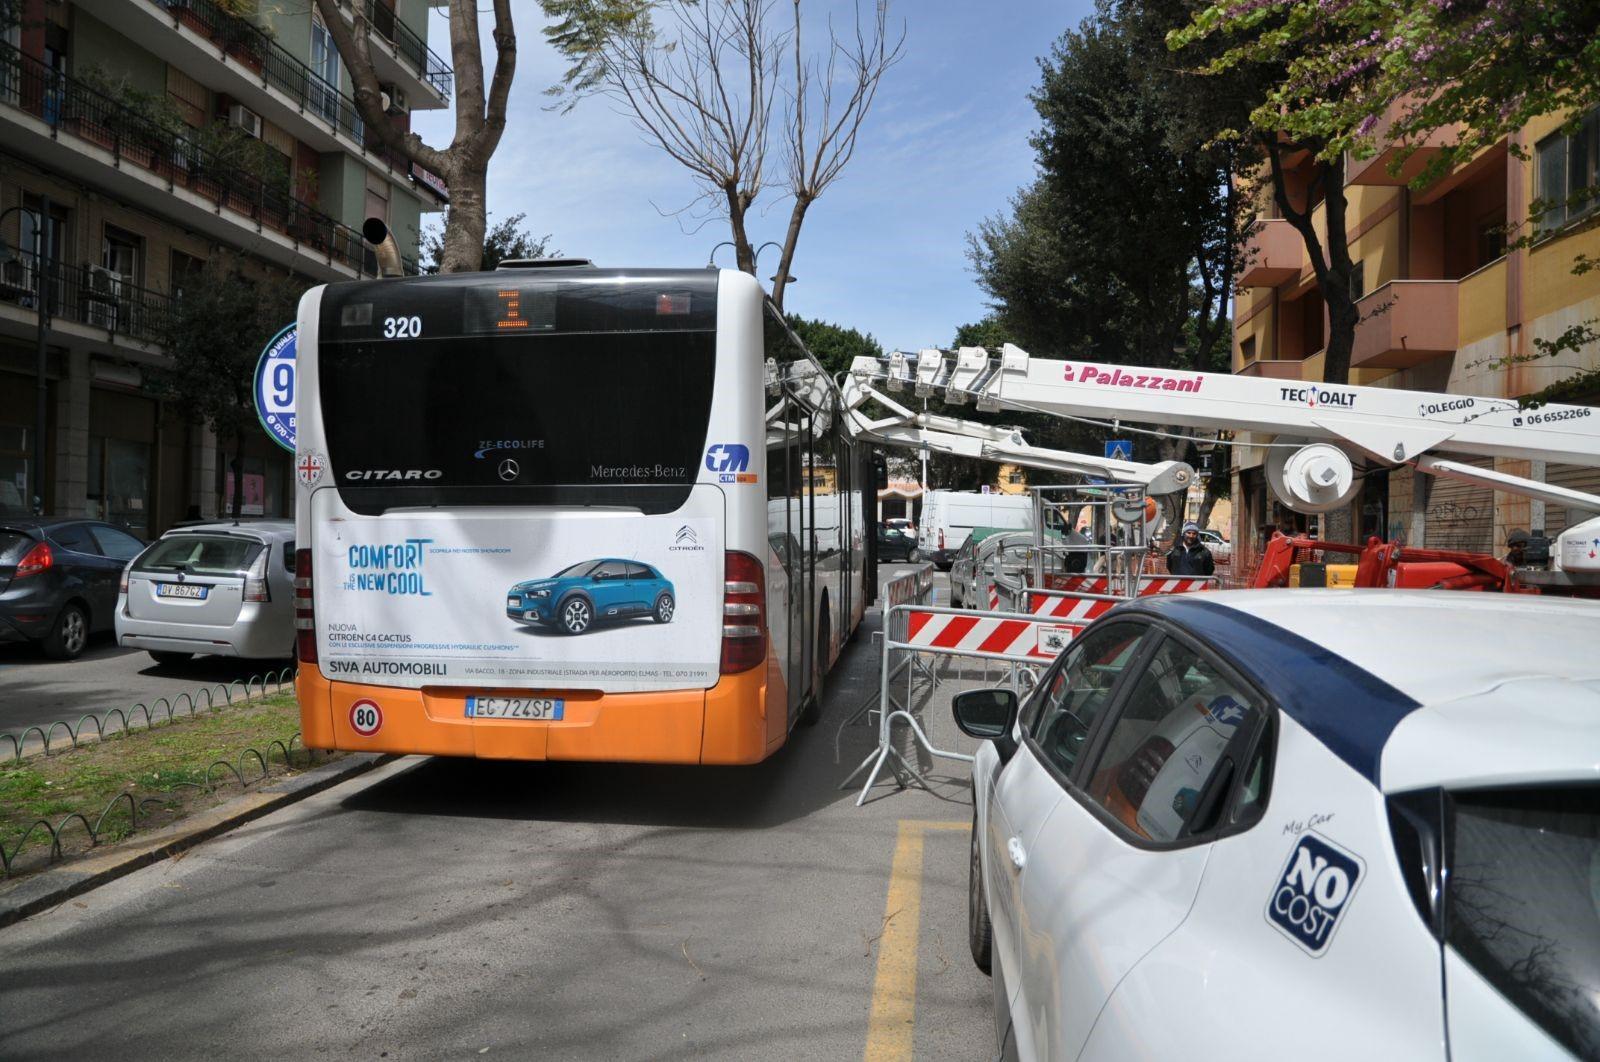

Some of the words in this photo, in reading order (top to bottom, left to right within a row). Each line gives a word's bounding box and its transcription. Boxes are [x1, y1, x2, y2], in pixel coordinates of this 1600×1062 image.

[384, 316, 422, 338] 320
[274, 331, 294, 350] VIALE
[273, 363, 295, 407] 9
[1079, 366, 1204, 393] Palazzani
[1527, 415, 1542, 425] 06
[1544, 408, 1591, 423] 6552266
[274, 423, 287, 437] 070
[479, 440, 545, 449] ZF-ECOLIFE
[345, 470, 442, 480] CITARO
[590, 464, 686, 478] Mercedes-Benz
[349, 539, 434, 569] COMFORT
[349, 573, 356, 582] IS
[357, 573, 385, 591] NEW
[387, 572, 432, 596] COOL
[343, 582, 356, 591] THE
[328, 623, 357, 632] NUOVA
[365, 634, 376, 642] C4
[378, 634, 412, 642] CACTUS
[329, 661, 359, 673] SIVA
[362, 661, 447, 675] AUTOMOBILI
[501, 699, 552, 717] 724SP
[356, 709, 376, 726] 80
[1282, 820, 1303, 836] My
[1307, 812, 1336, 829] Car
[1286, 846, 1350, 909] NO
[1275, 886, 1335, 941] COST
